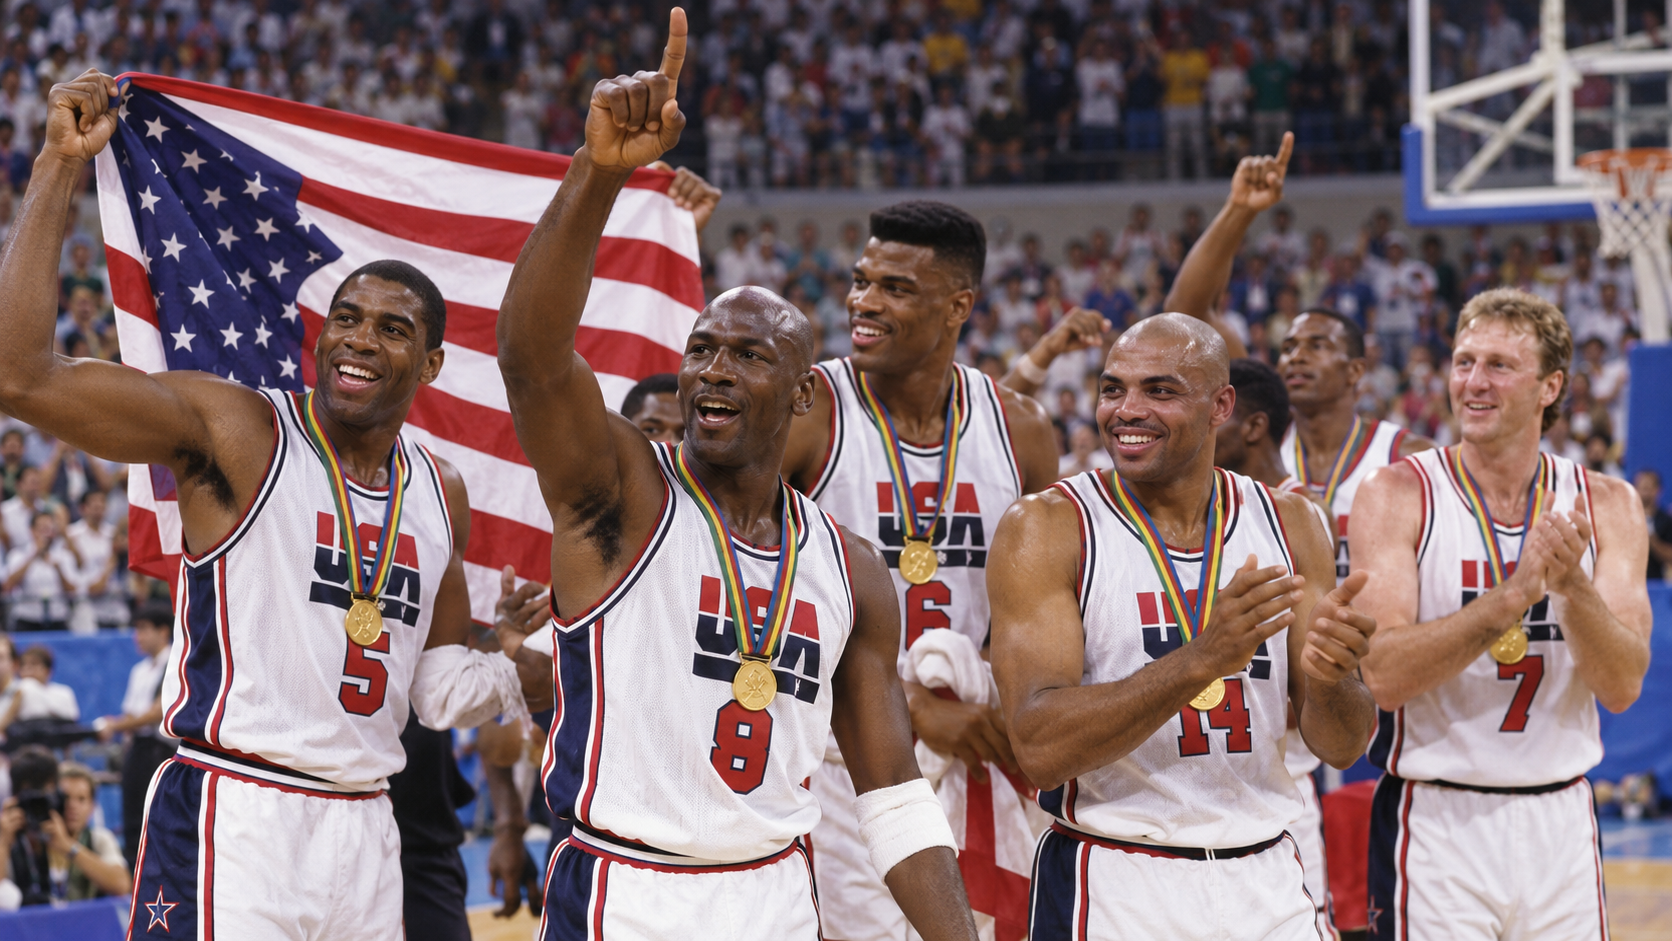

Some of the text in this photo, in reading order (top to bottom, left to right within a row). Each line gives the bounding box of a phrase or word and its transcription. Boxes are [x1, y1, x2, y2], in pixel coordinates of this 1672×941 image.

[905, 581, 952, 652] 6
[338, 631, 390, 717] 5
[1496, 654, 1544, 732] 7
[710, 699, 773, 795] 8
[1177, 678, 1252, 758] 14
